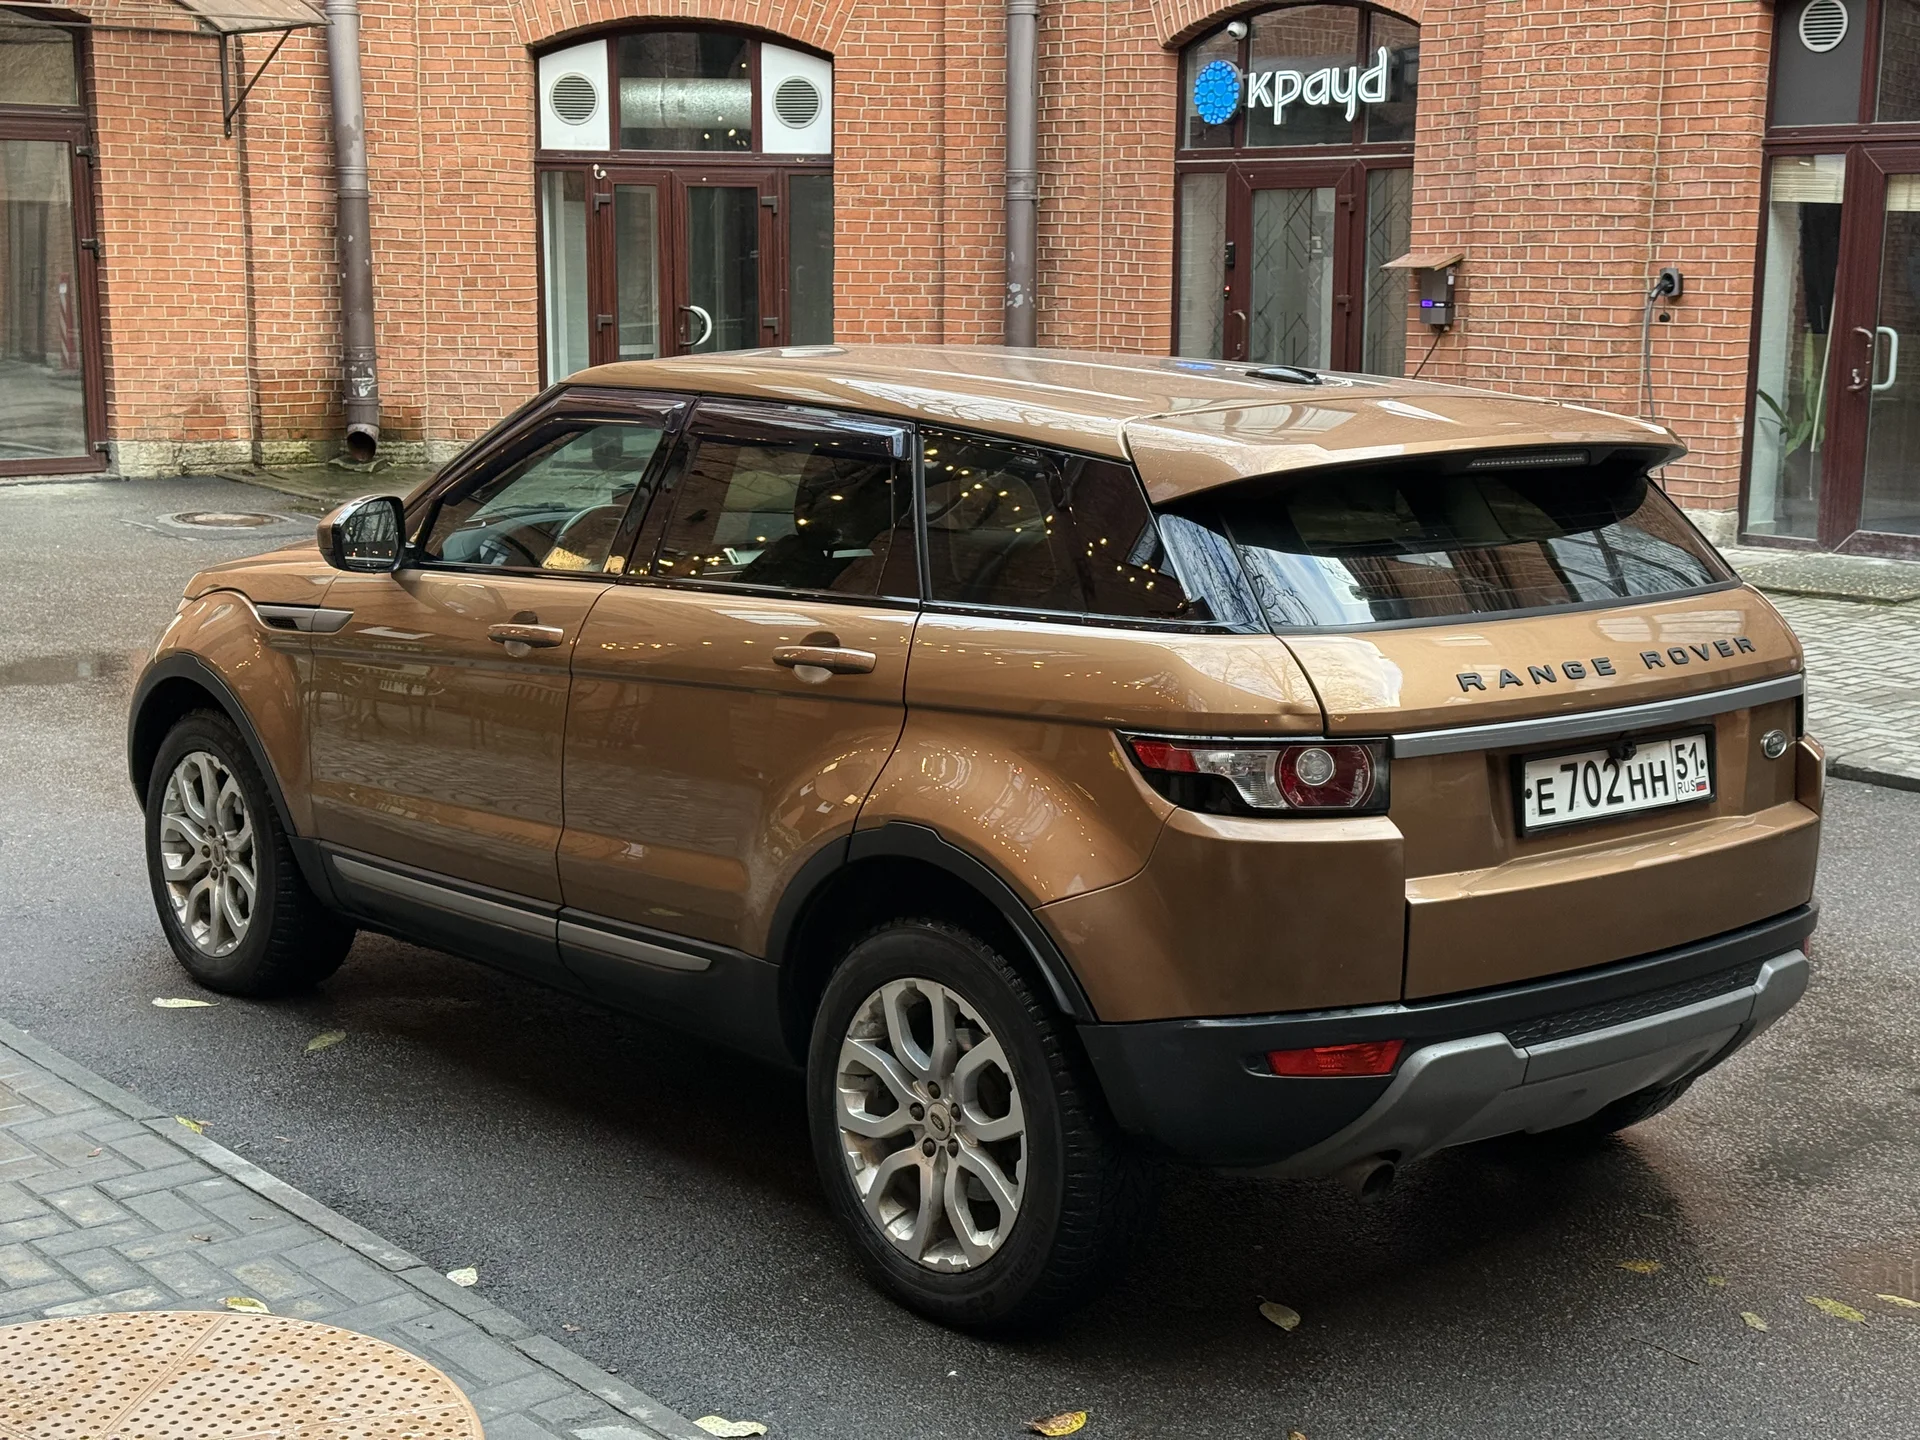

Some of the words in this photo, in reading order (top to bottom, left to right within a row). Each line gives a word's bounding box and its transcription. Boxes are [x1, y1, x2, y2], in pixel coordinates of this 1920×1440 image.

[1456, 656, 1617, 692] RANGE
[1639, 636, 1757, 670] ROVER
[1674, 742, 1700, 780] 51
[1676, 780, 1696, 795] RUS
